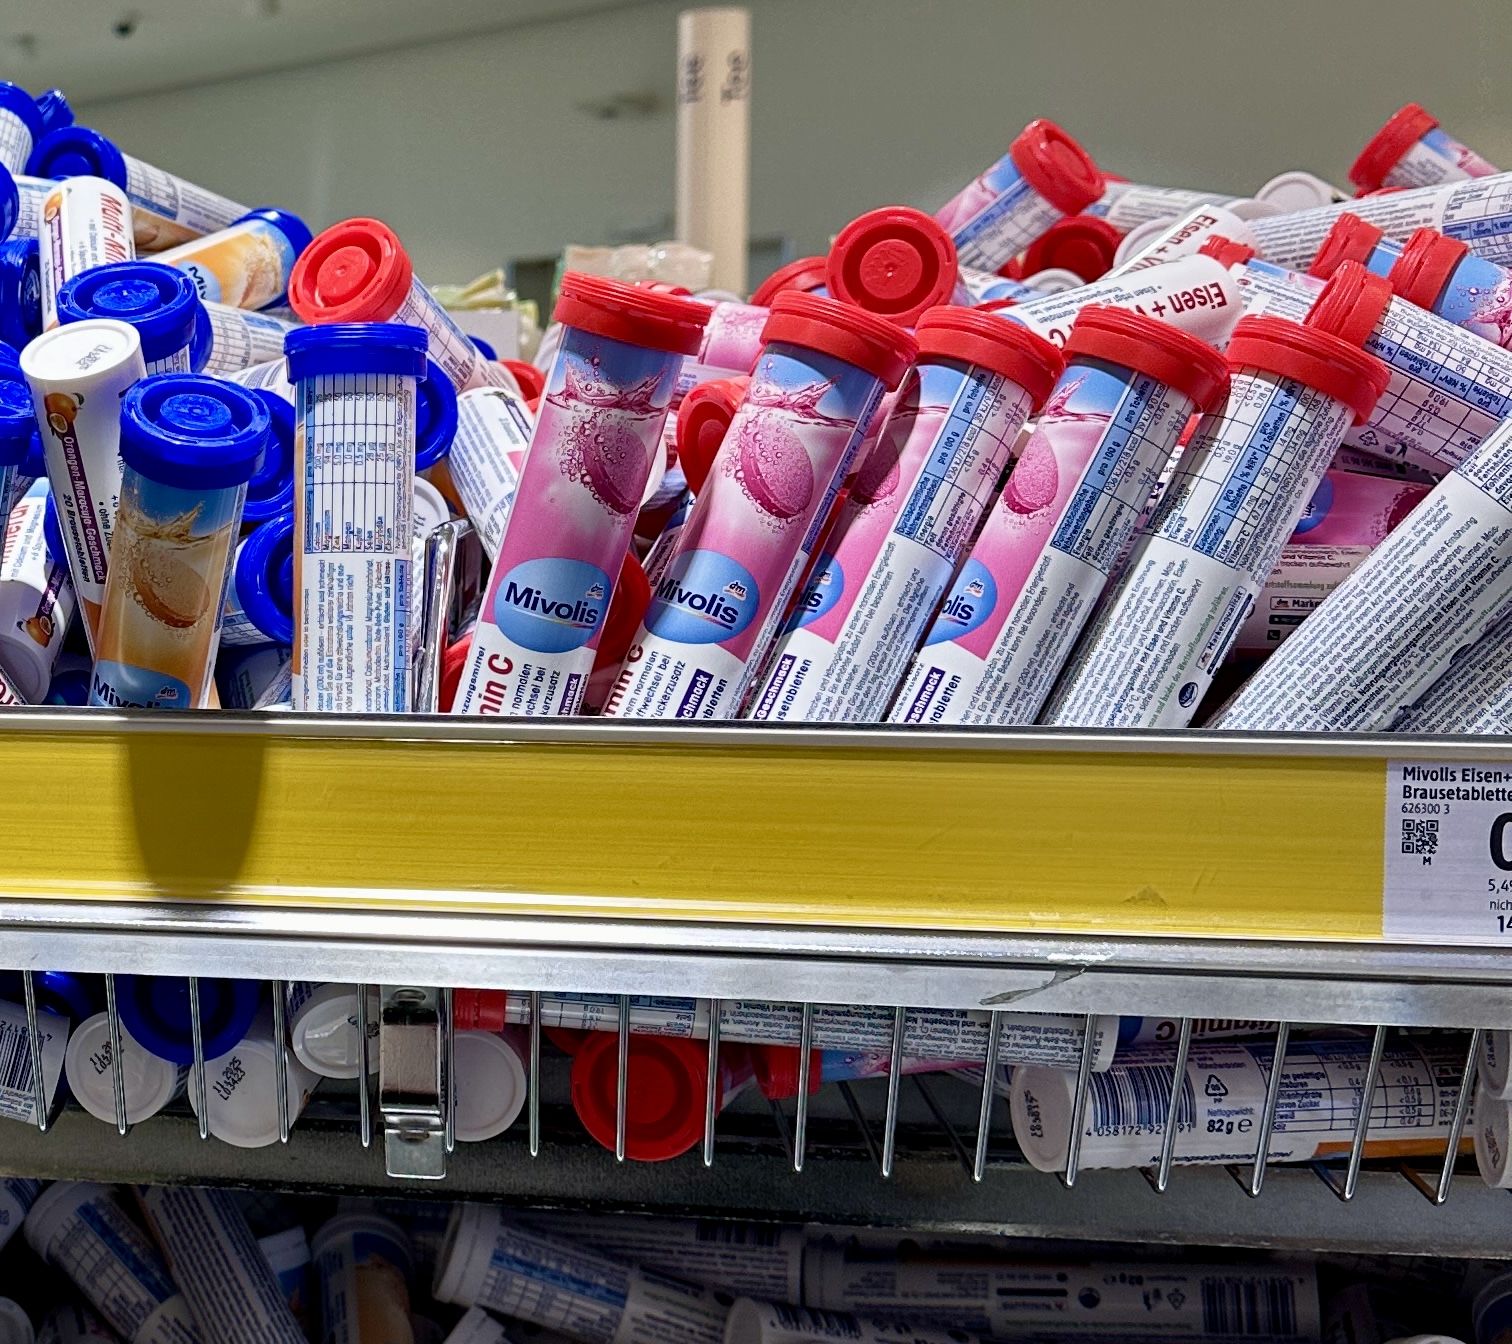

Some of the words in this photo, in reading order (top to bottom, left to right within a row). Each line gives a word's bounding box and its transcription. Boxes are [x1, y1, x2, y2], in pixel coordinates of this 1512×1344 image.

[1168, 282, 1228, 313] Eisen
[63, 436, 104, 581] Orangen-Maracuja-Geschmack
[504, 581, 599, 625] Mivolis
[656, 577, 739, 626] Mivolis
[488, 654, 514, 674] C
[756, 655, 794, 719] Geschmack
[1402, 766, 1457, 782] Mivolis
[1461, 768, 1512, 783] Eisen+
[1401, 803, 1441, 814] 626300
[1443, 804, 1450, 814] 3
[1402, 785, 1512, 802] Brausetablette
